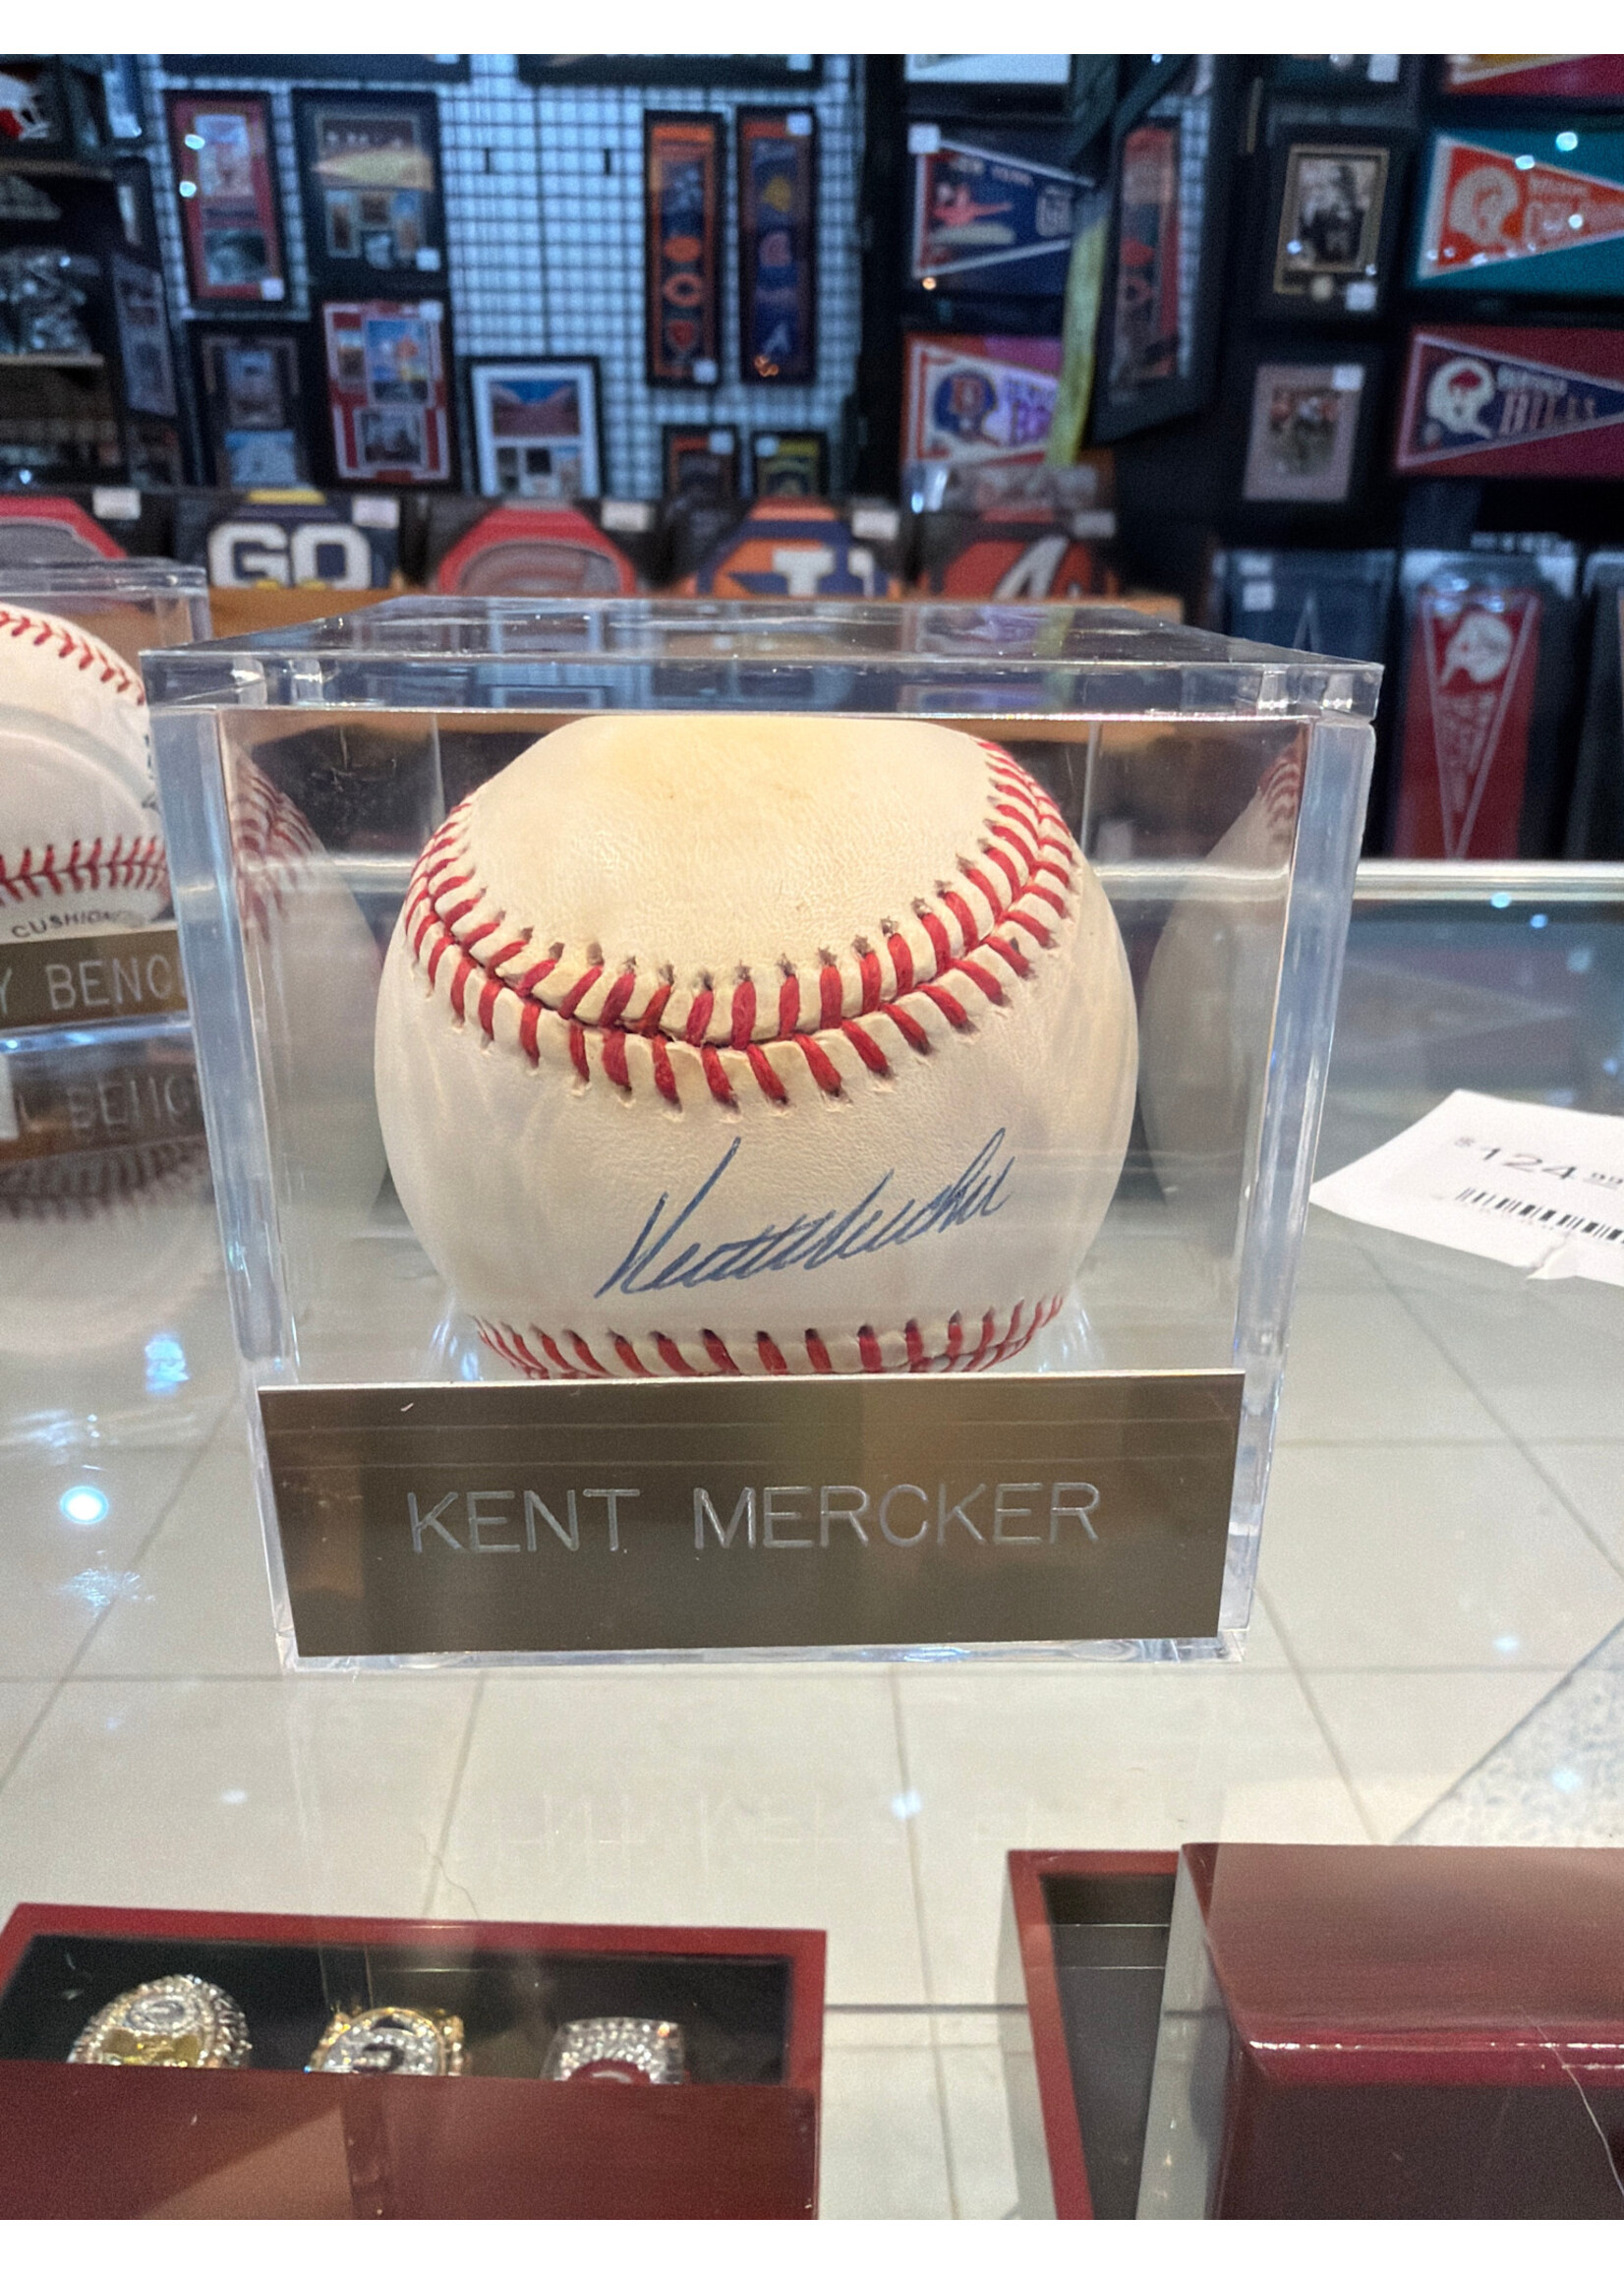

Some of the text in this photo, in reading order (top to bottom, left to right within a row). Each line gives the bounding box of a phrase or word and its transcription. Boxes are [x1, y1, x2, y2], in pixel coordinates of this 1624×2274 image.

[207, 522, 372, 590] GO
[45, 954, 189, 1011] BENC
[407, 1482, 1102, 1552] KENT MERCKER
